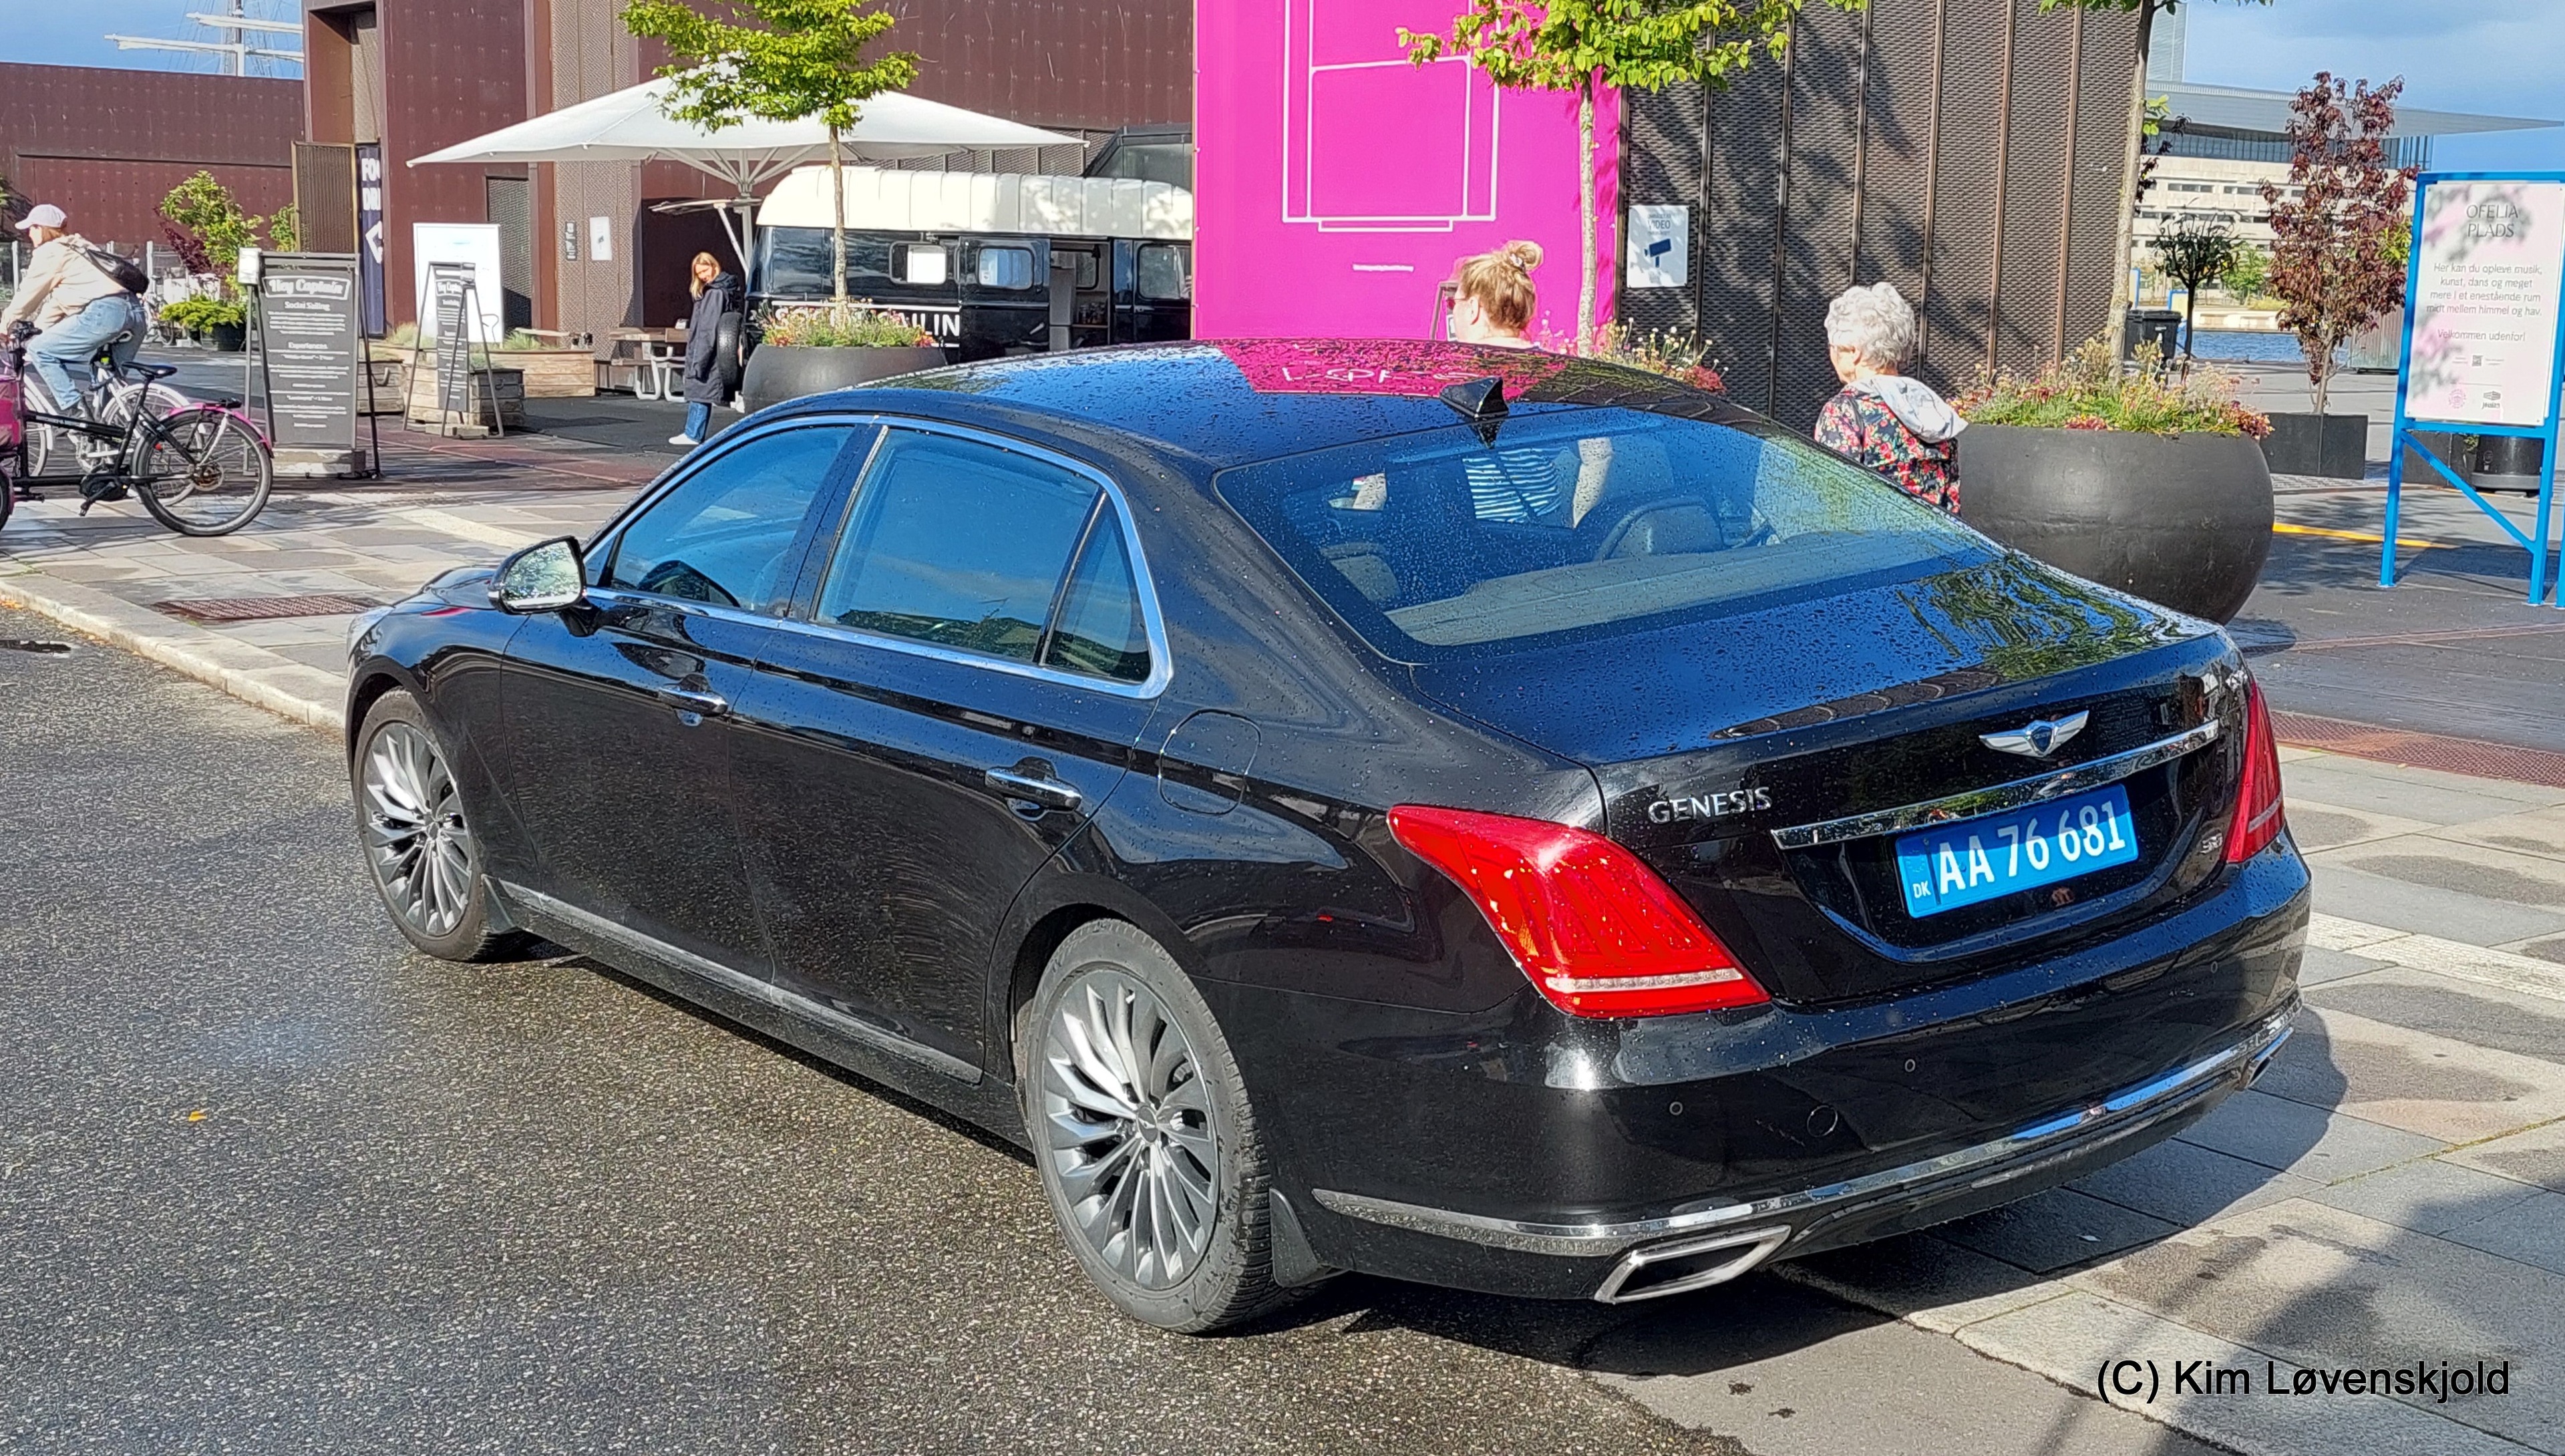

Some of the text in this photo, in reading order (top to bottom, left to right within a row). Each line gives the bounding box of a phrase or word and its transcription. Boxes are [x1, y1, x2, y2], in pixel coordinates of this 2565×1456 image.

[2466, 204, 2519, 218] OFELIA
[2467, 223, 2514, 238] PLADS
[2433, 262, 2449, 272] Her
[2451, 262, 2466, 273] kan
[2469, 263, 2480, 273] du
[2482, 263, 2512, 275] opleve
[2468, 277, 2488, 287] dans
[2492, 279, 2502, 289] og
[2505, 279, 2532, 289] meget
[2430, 291, 2451, 299] mere
[2459, 291, 2467, 300] et
[2524, 293, 2541, 302] rum
[2427, 305, 2542, 317] midt mellem himmel og hav.
[2437, 329, 2486, 340] Velkommen
[1648, 787, 1772, 824] GENESIS
[1939, 800, 2125, 894] AA 76 681
[1912, 881, 1931, 898] DK
